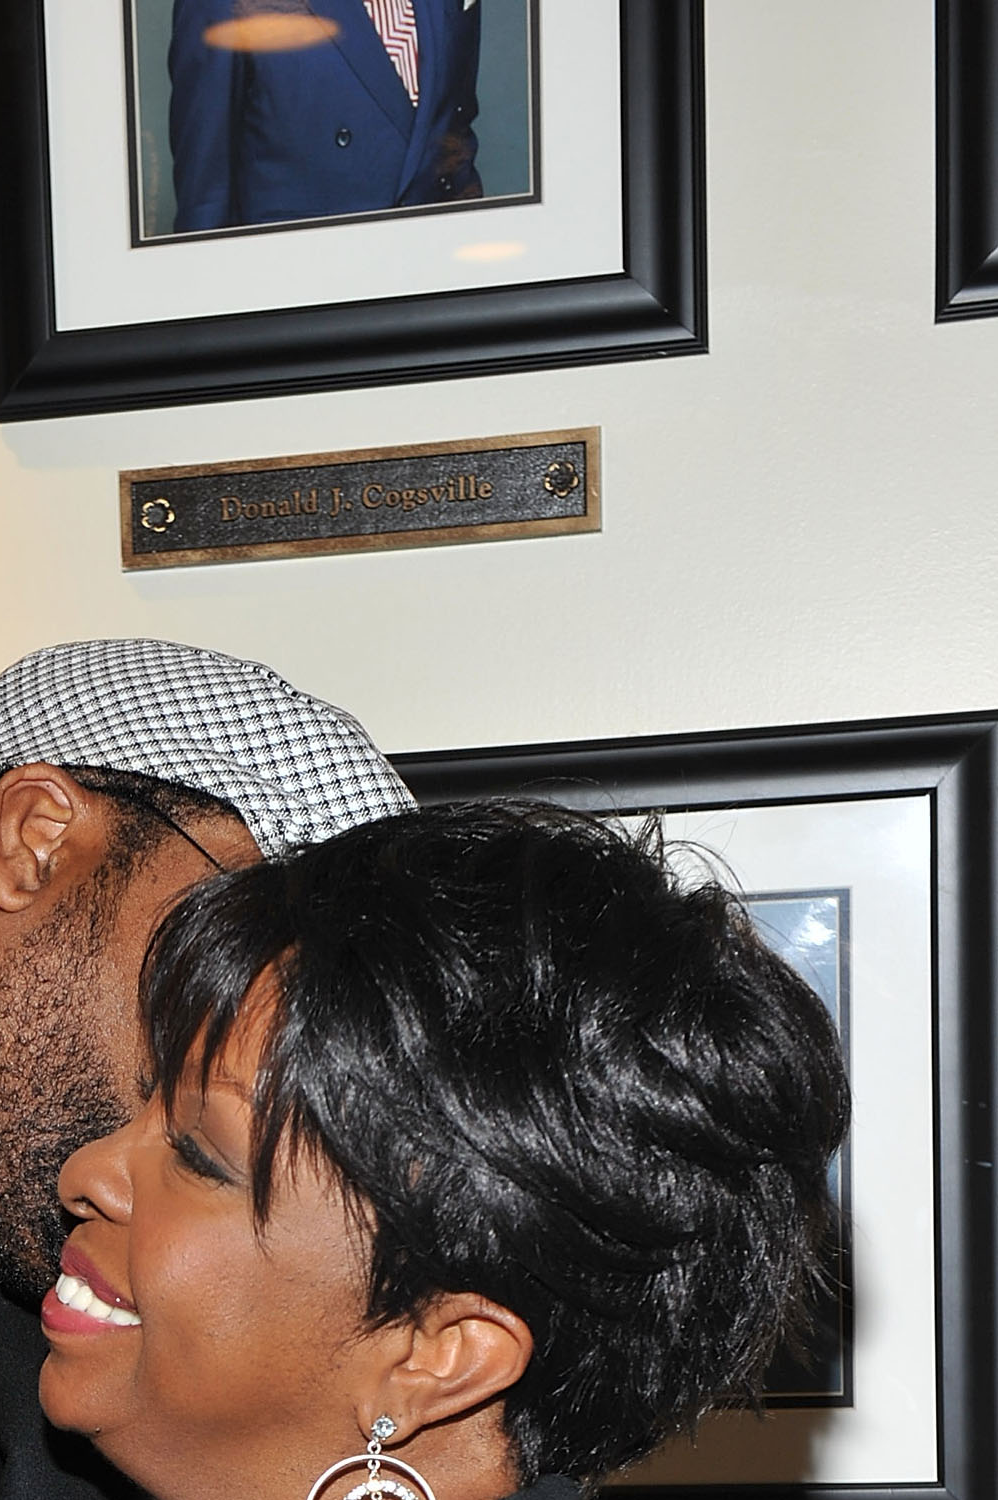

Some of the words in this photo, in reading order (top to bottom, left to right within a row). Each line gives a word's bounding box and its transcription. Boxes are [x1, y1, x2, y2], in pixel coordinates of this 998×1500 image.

[221, 488, 319, 522] Donald
[330, 487, 352, 517] J.
[362, 474, 494, 511] Cogsville
